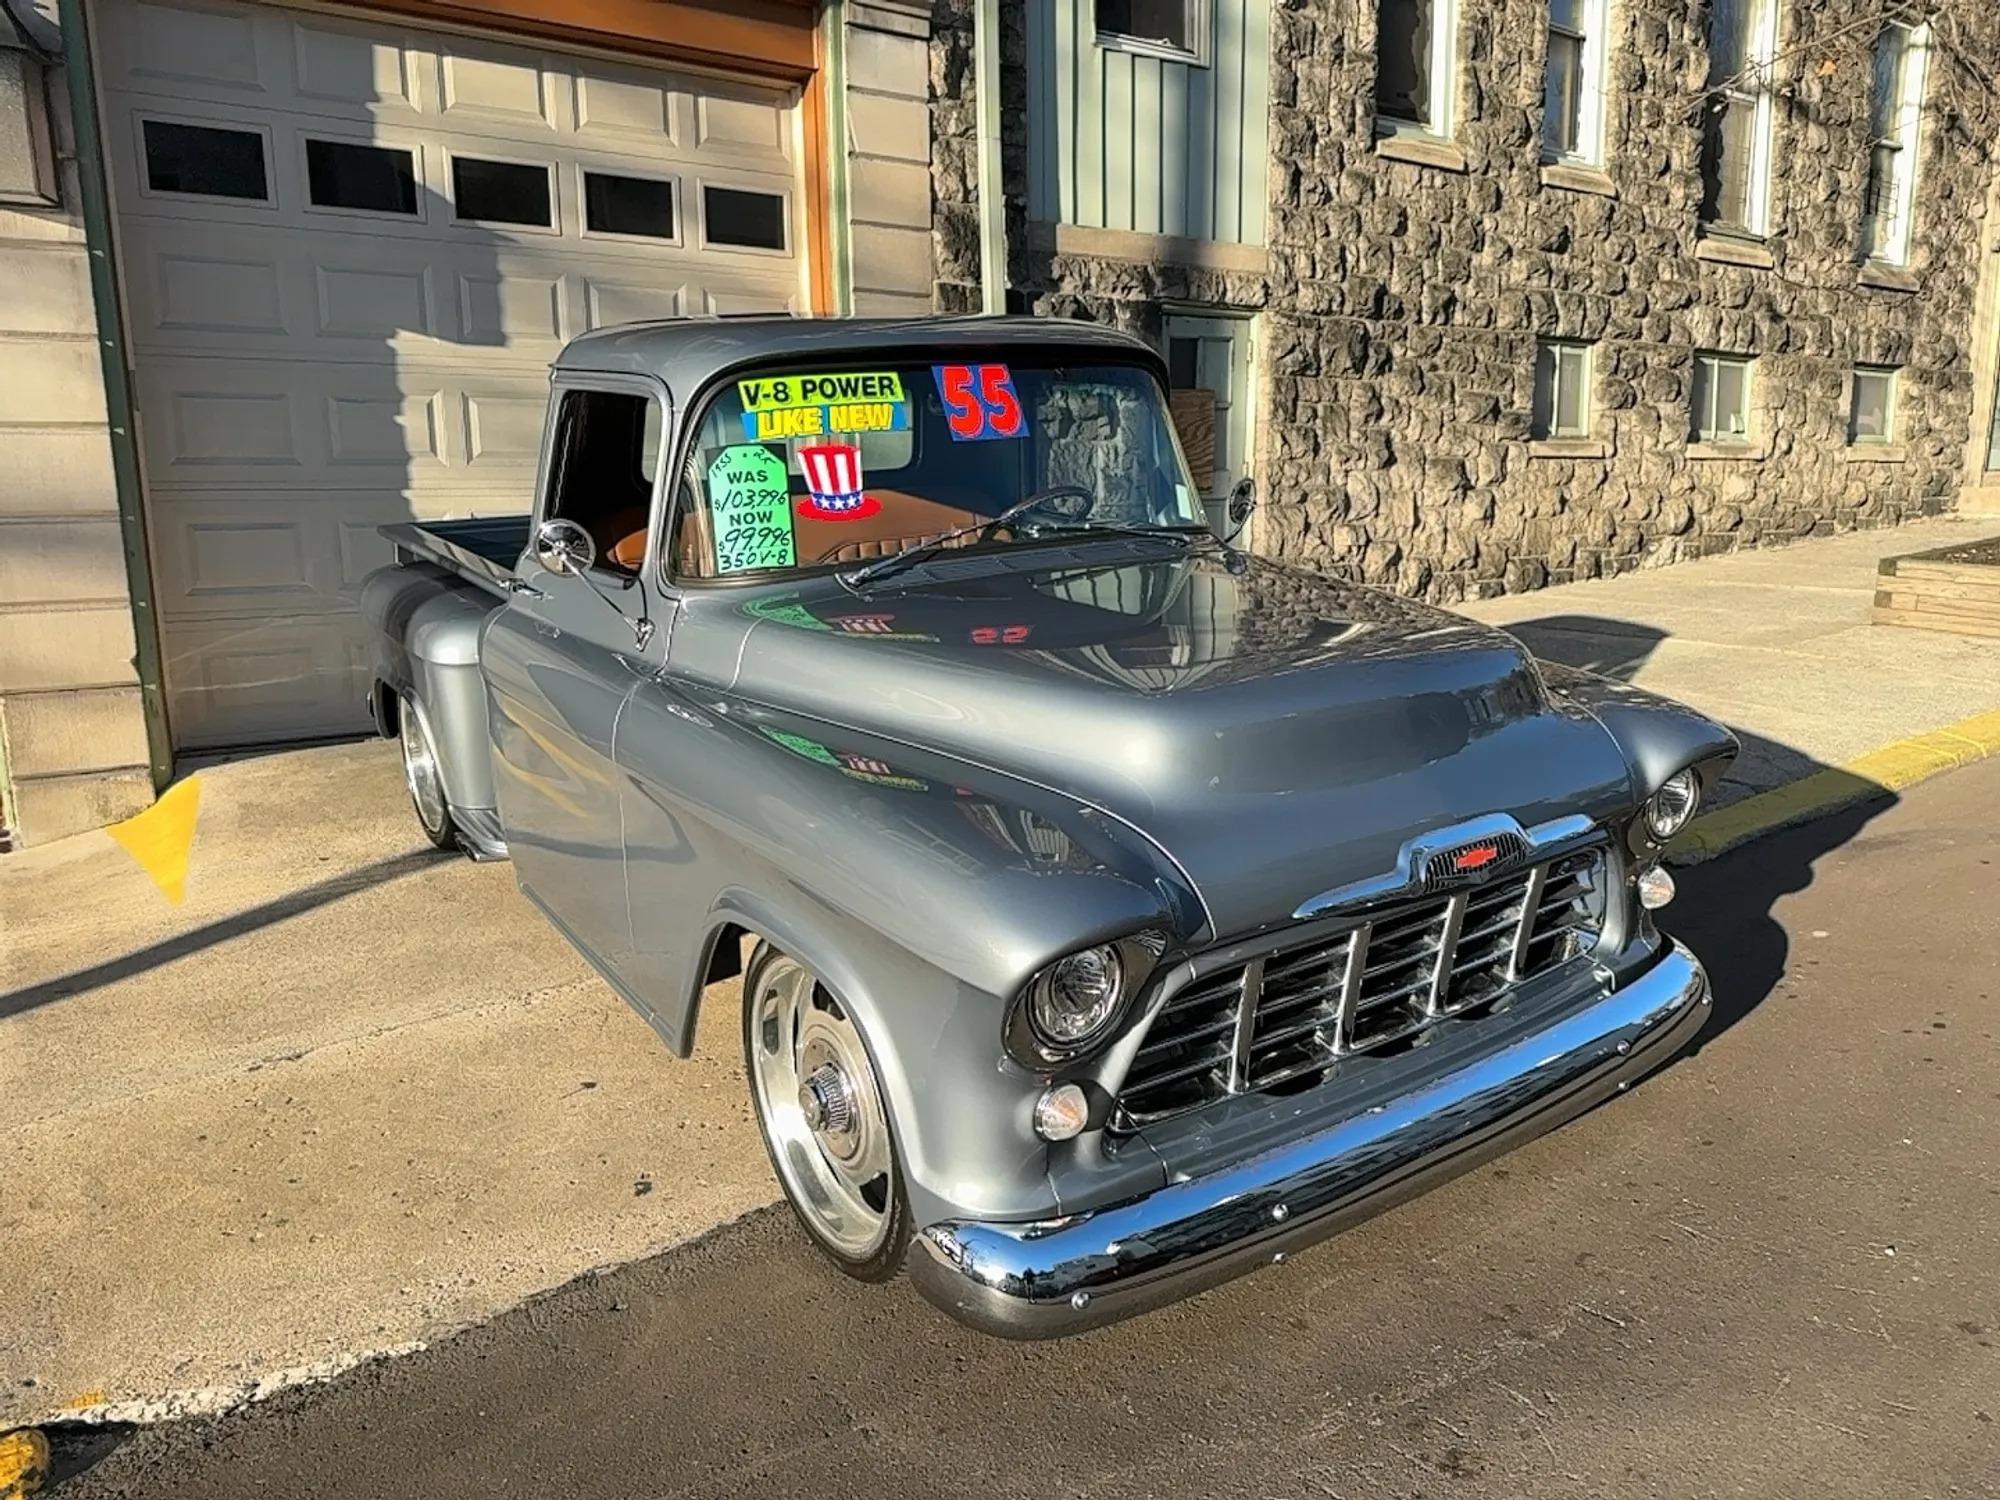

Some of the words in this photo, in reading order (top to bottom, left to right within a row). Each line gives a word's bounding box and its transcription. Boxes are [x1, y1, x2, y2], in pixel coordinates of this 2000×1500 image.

[743, 382, 789, 407] V-8
[801, 376, 895, 400] POWER
[942, 364, 1022, 438] 55
[757, 407, 823, 438] LIKE
[829, 403, 893, 432] NEW
[727, 469, 769, 485] WAS
[729, 510, 773, 527] NOW
